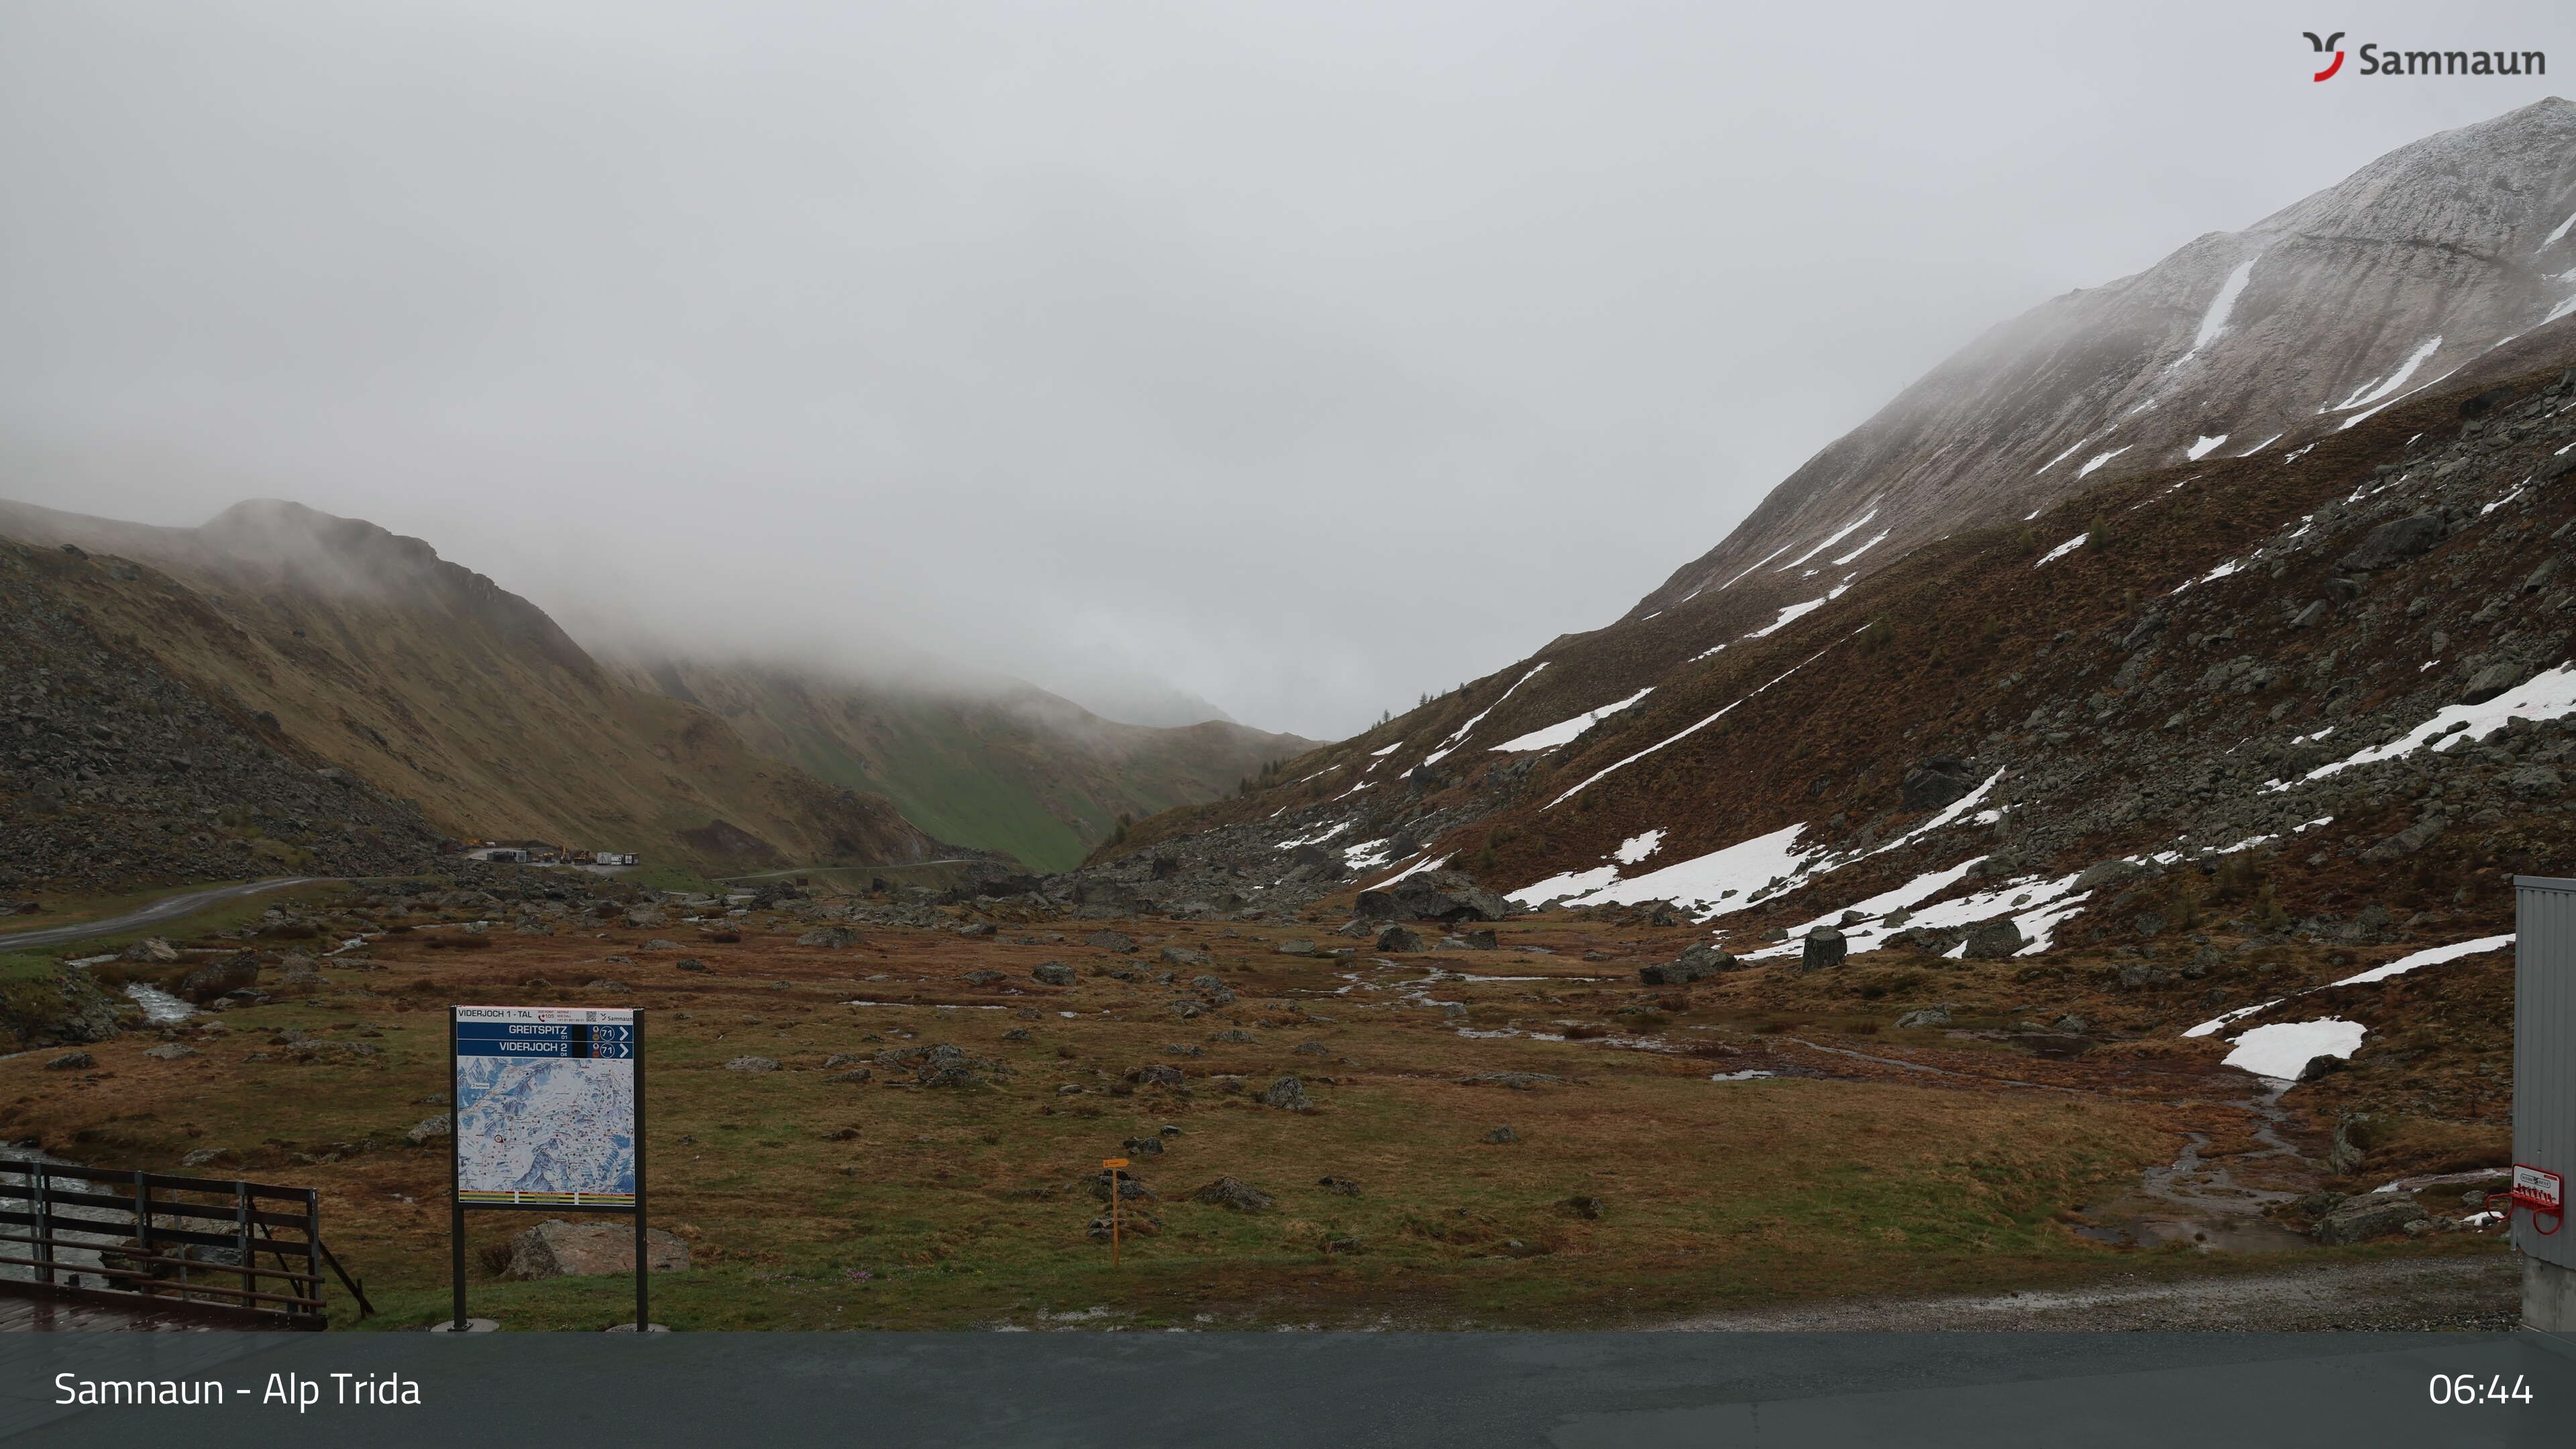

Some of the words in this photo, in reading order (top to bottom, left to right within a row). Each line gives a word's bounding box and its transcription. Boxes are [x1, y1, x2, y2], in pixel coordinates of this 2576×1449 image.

[458, 1009, 504, 1018] VIDERJOCH
[508, 1025, 568, 1034] GREITSPITZ
[499, 1042, 557, 1051] VIDERJOCH
[560, 1043, 567, 1052] 2
